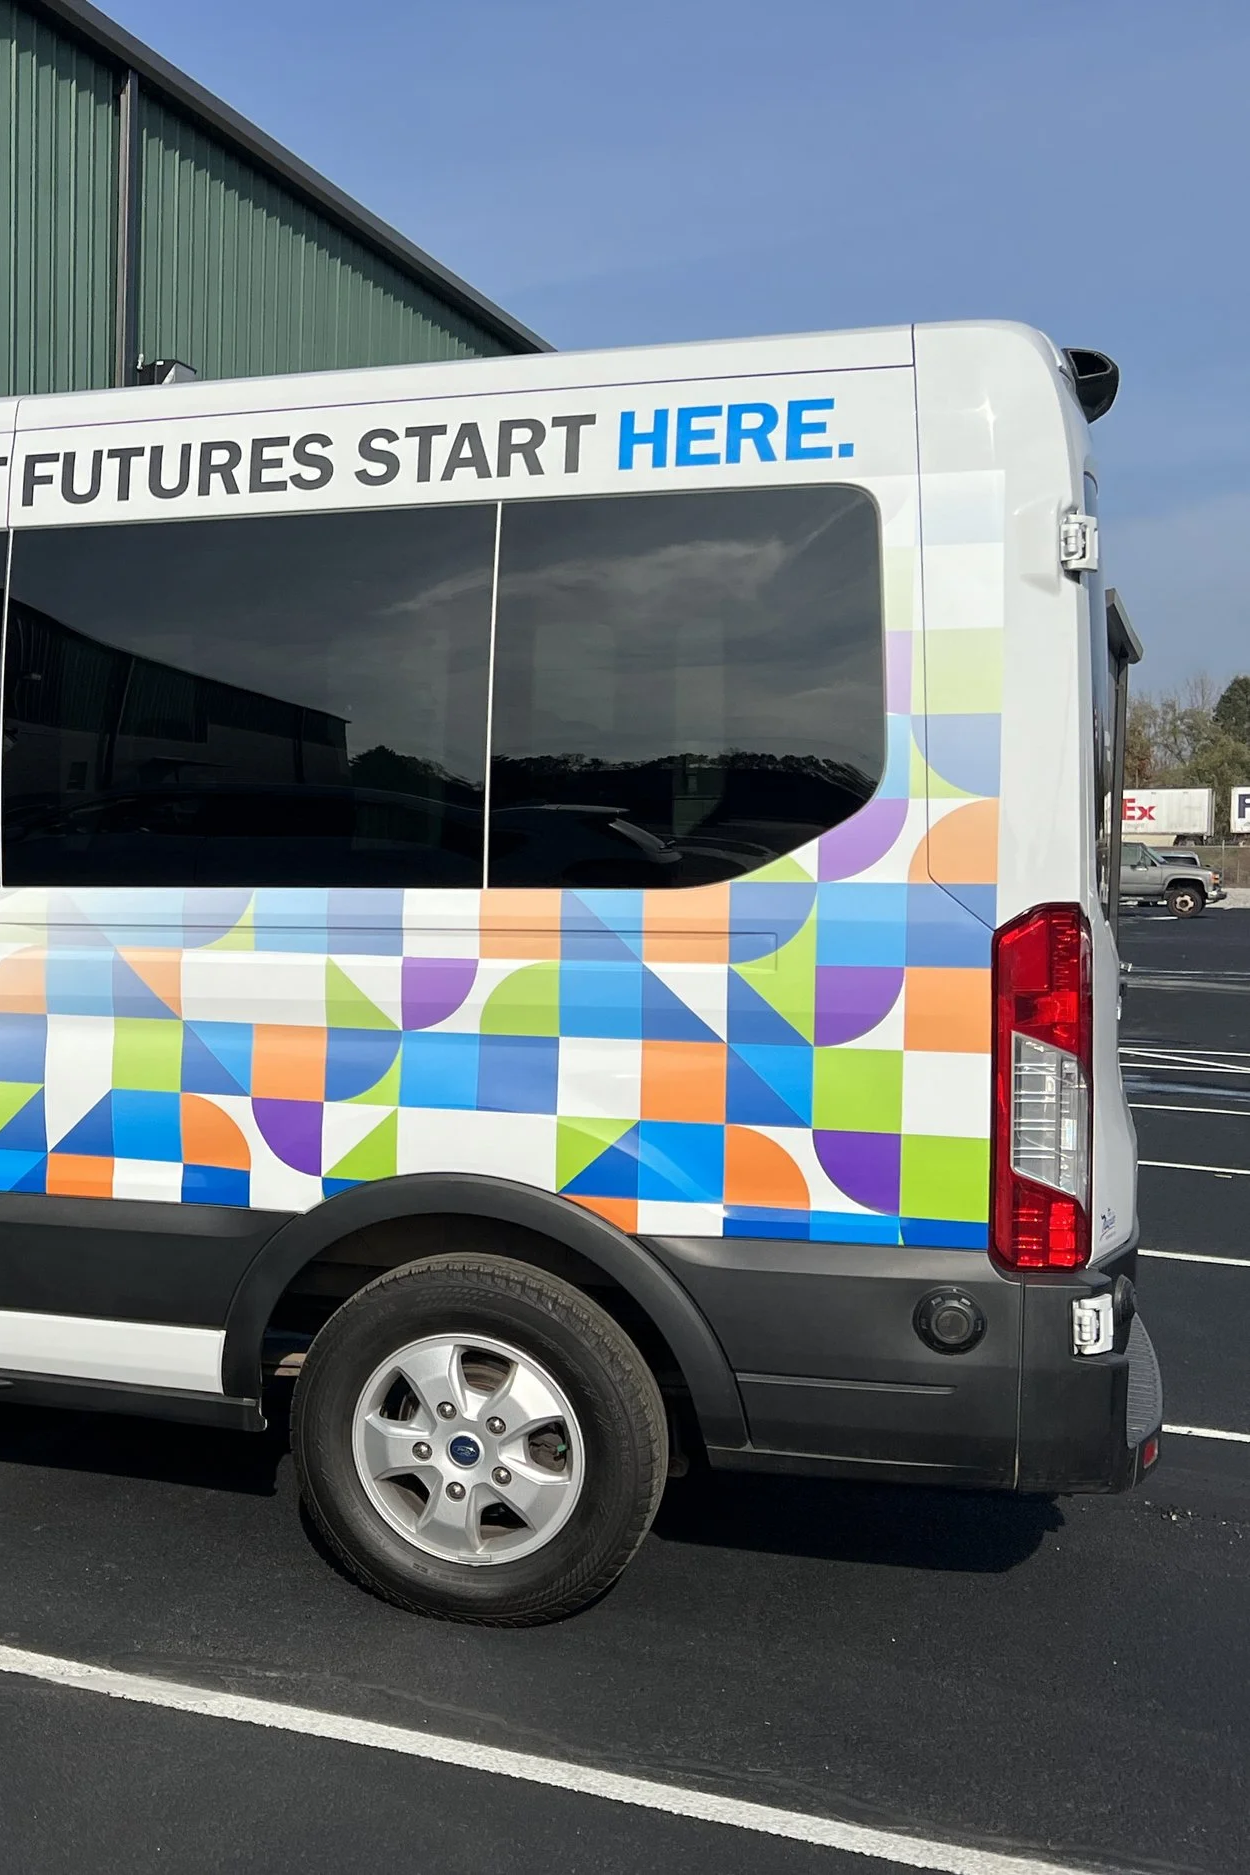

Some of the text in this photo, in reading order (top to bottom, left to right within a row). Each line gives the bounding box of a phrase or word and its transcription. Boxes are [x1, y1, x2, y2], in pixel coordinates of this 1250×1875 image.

[22, 433, 334, 507] FUTURES
[354, 413, 597, 486] START
[618, 398, 855, 471] HERE.
